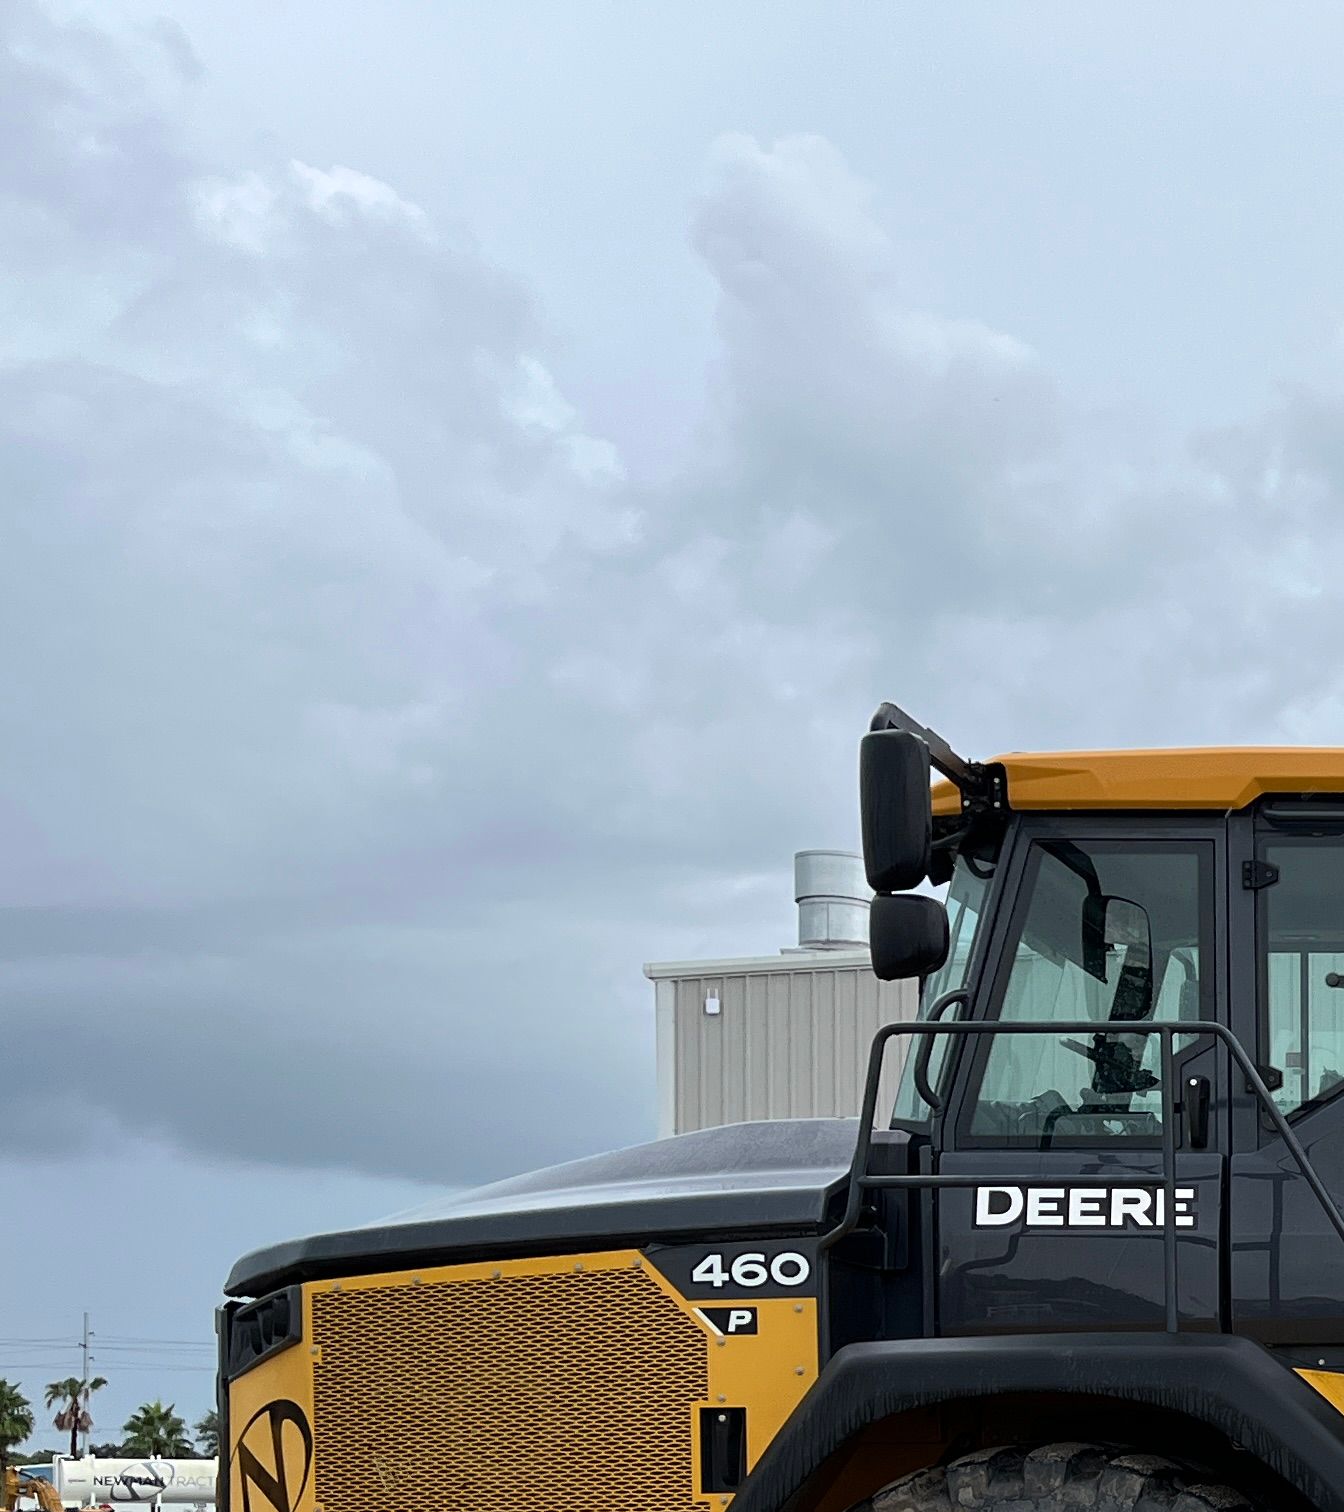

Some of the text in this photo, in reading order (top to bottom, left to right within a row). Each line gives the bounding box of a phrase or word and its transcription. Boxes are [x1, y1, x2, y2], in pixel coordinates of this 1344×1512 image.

[975, 1186, 1194, 1226] DEERE
[692, 1252, 810, 1287] 460
[728, 1310, 752, 1332] P
[93, 1475, 165, 1487] NEWMAN
